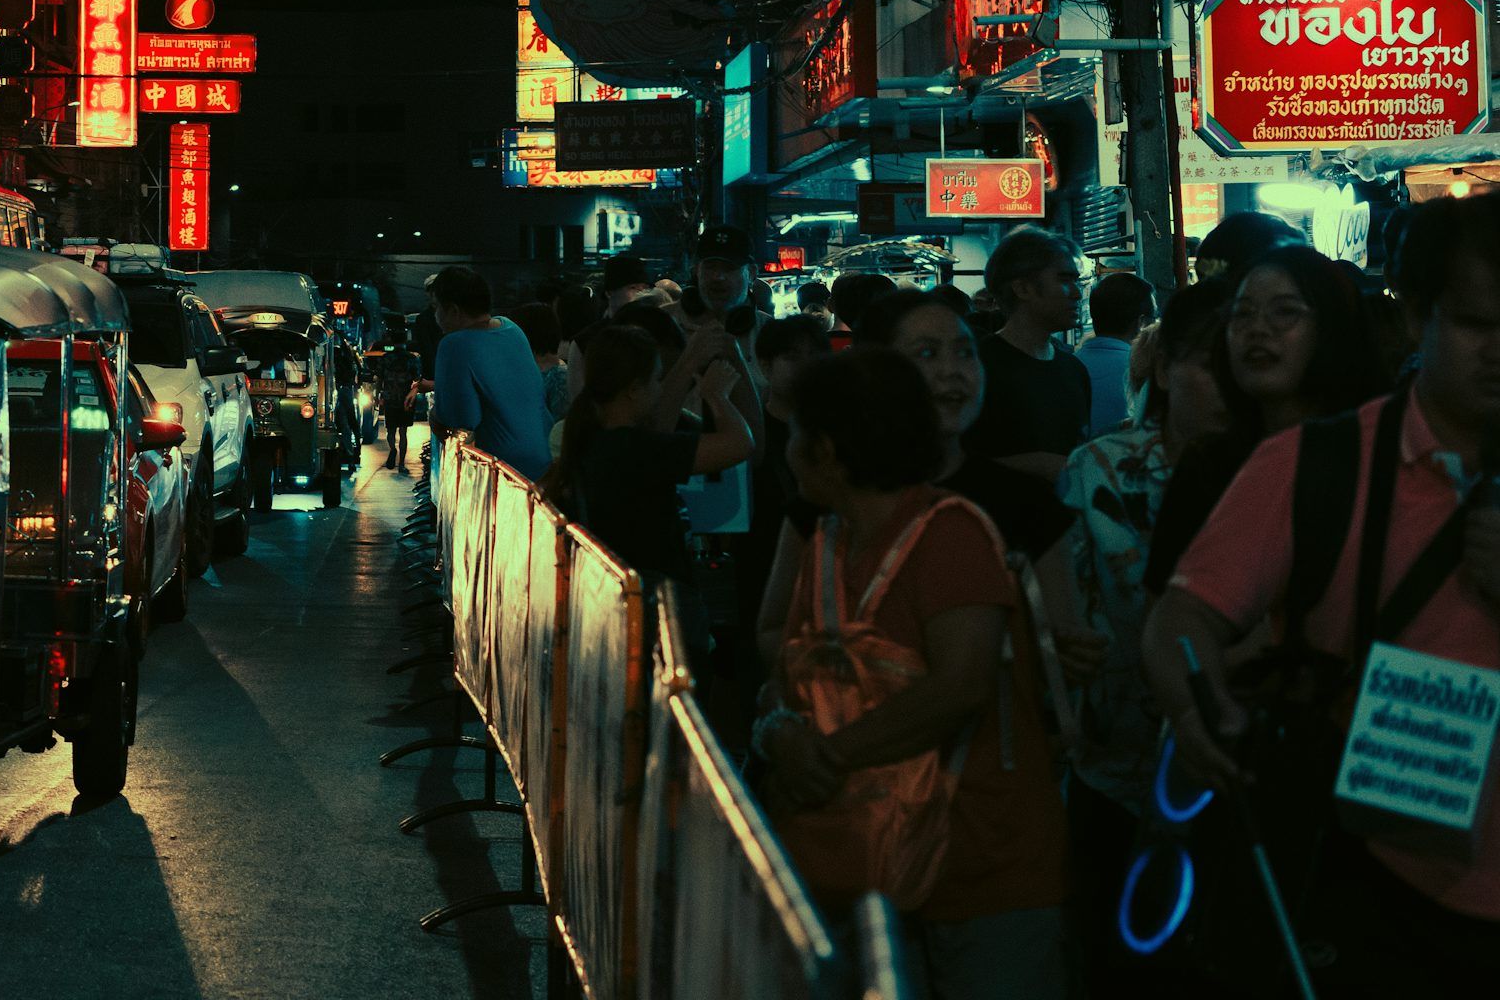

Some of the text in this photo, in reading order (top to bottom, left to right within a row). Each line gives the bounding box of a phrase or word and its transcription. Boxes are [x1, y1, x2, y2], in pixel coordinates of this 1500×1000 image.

[137, 51, 250, 69] ชน่าทาวน์ สกาล่า
[1362, 40, 1470, 67] เยาวราช
[1224, 70, 1294, 92] จำหน่าย
[145, 82, 230, 110] 中國城
[943, 171, 977, 188] ยาจีน
